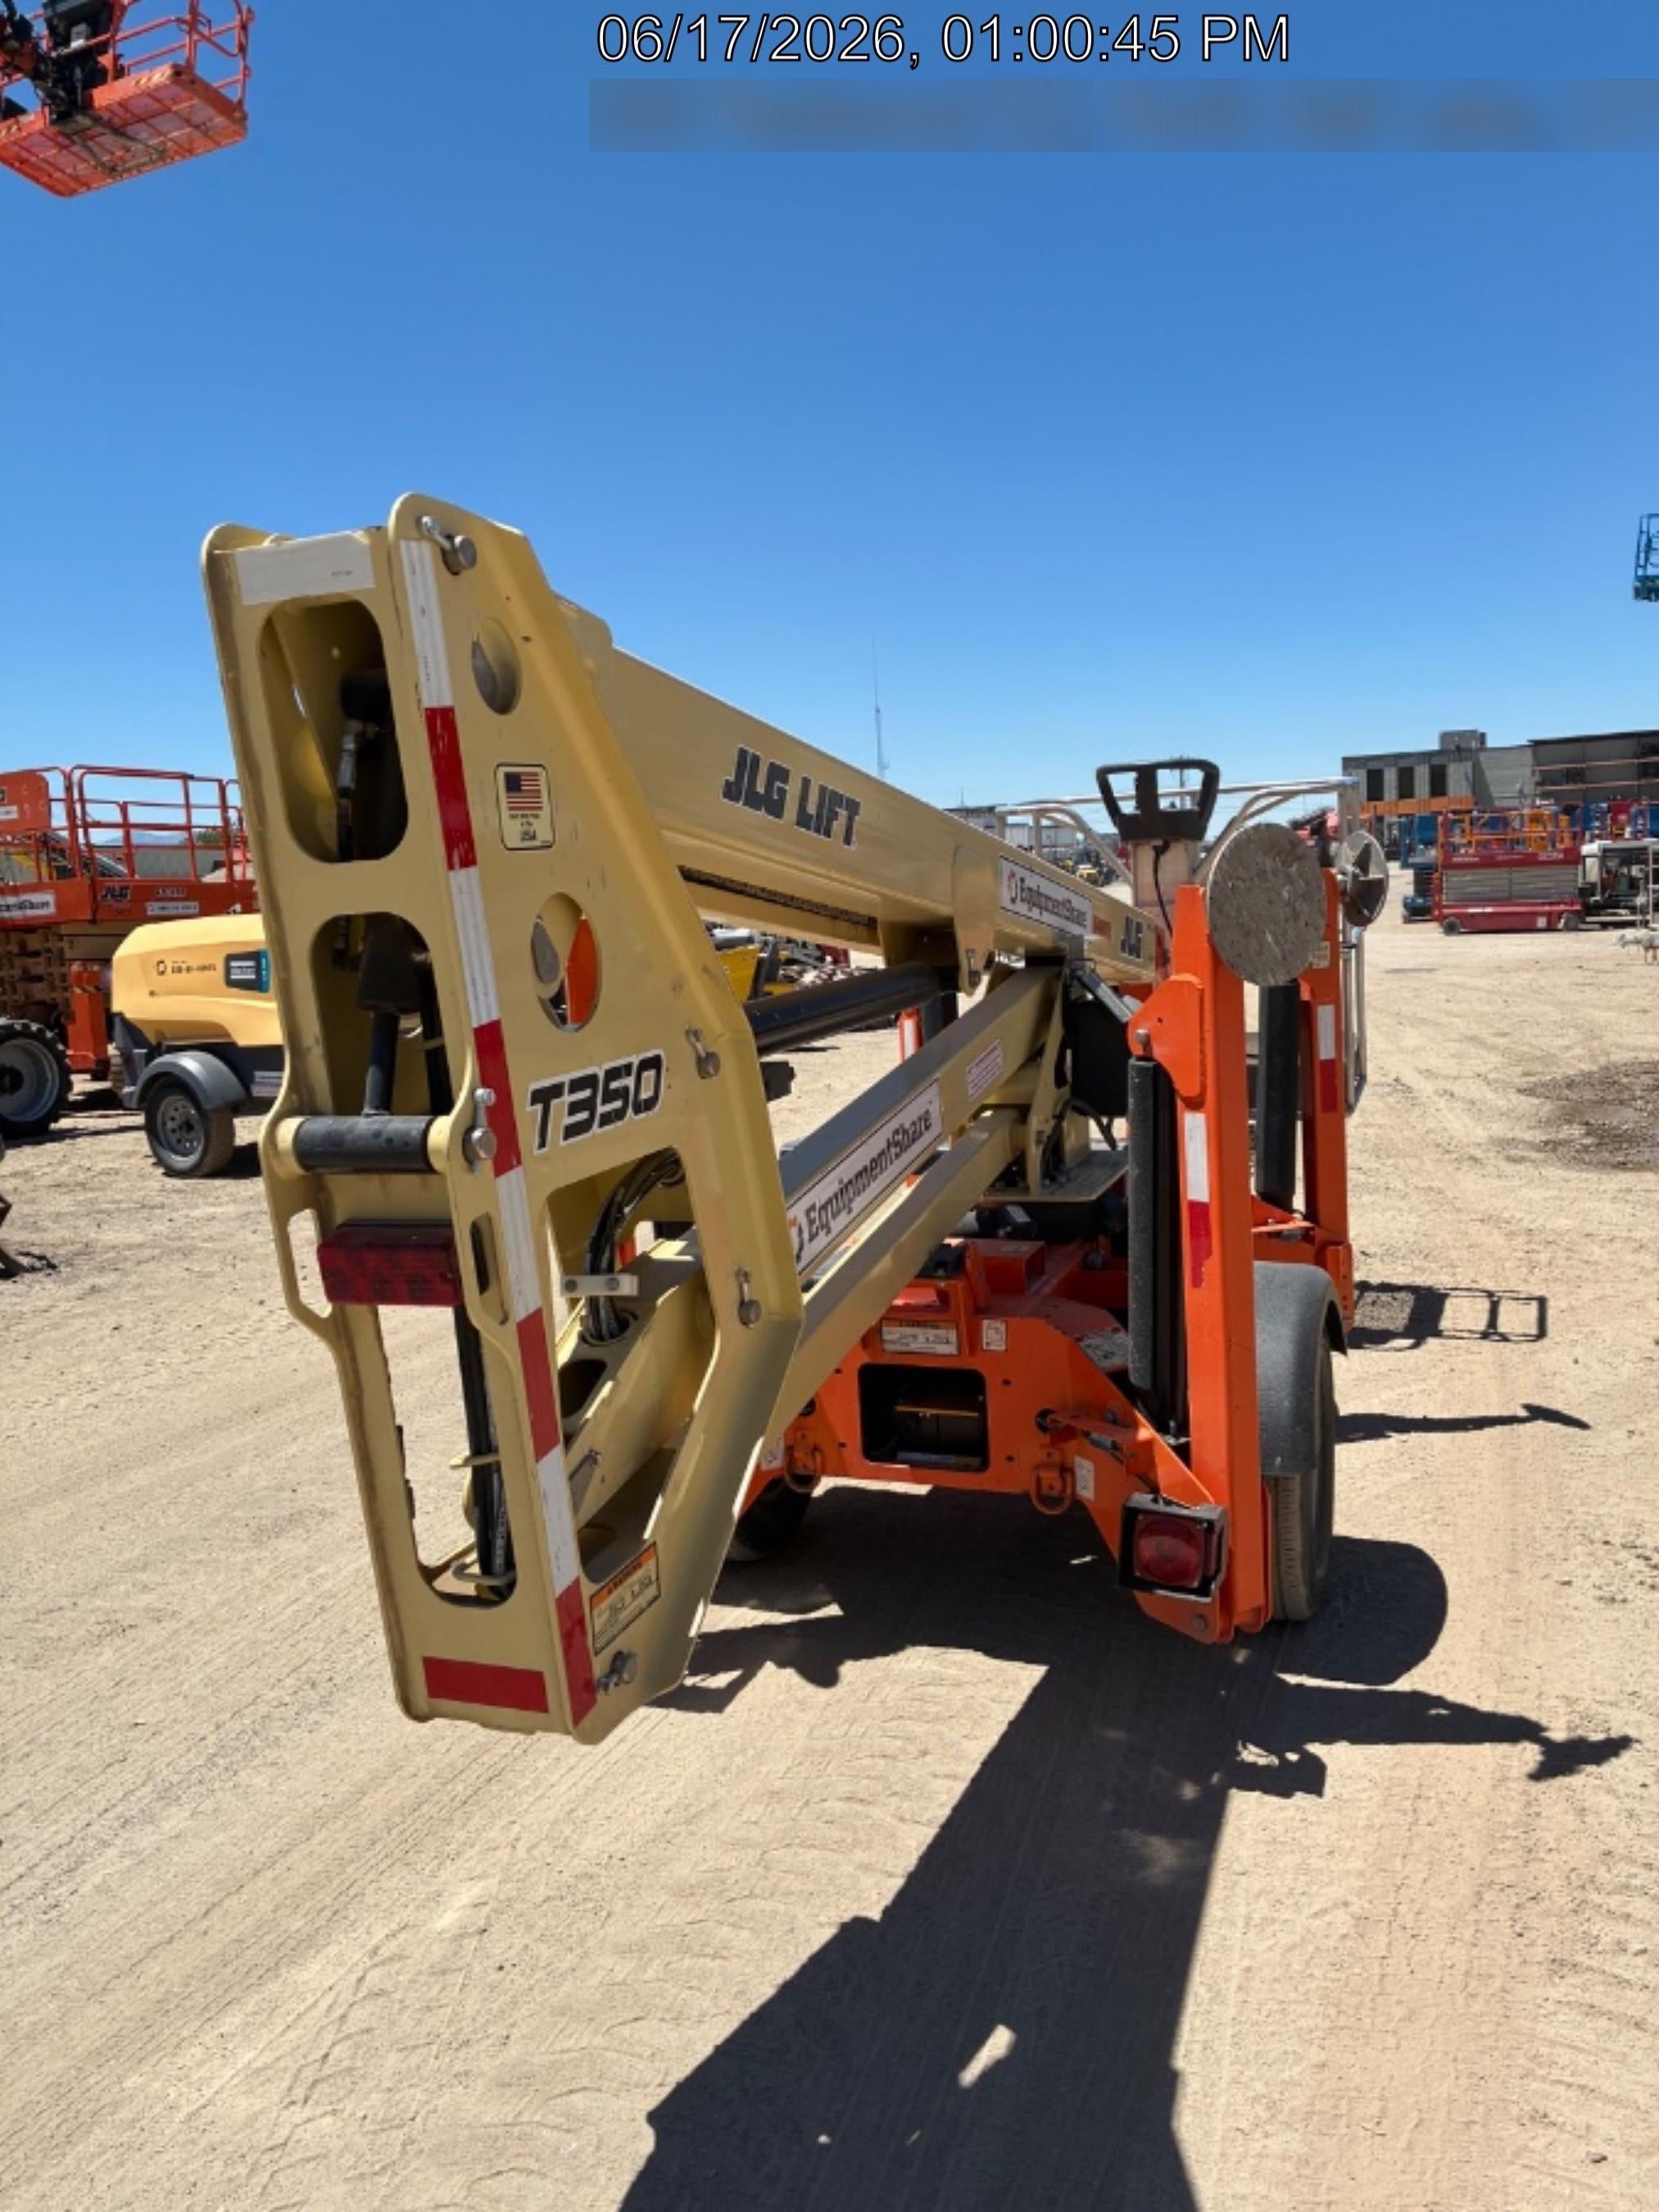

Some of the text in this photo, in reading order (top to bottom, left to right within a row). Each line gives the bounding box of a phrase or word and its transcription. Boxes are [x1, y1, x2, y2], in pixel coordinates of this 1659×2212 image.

[723, 746, 861, 850] JLG LIFT
[1018, 877, 1089, 930] EquipmentShare
[527, 1050, 664, 1154] T350
[805, 1108, 932, 1244] EquipmentShare
